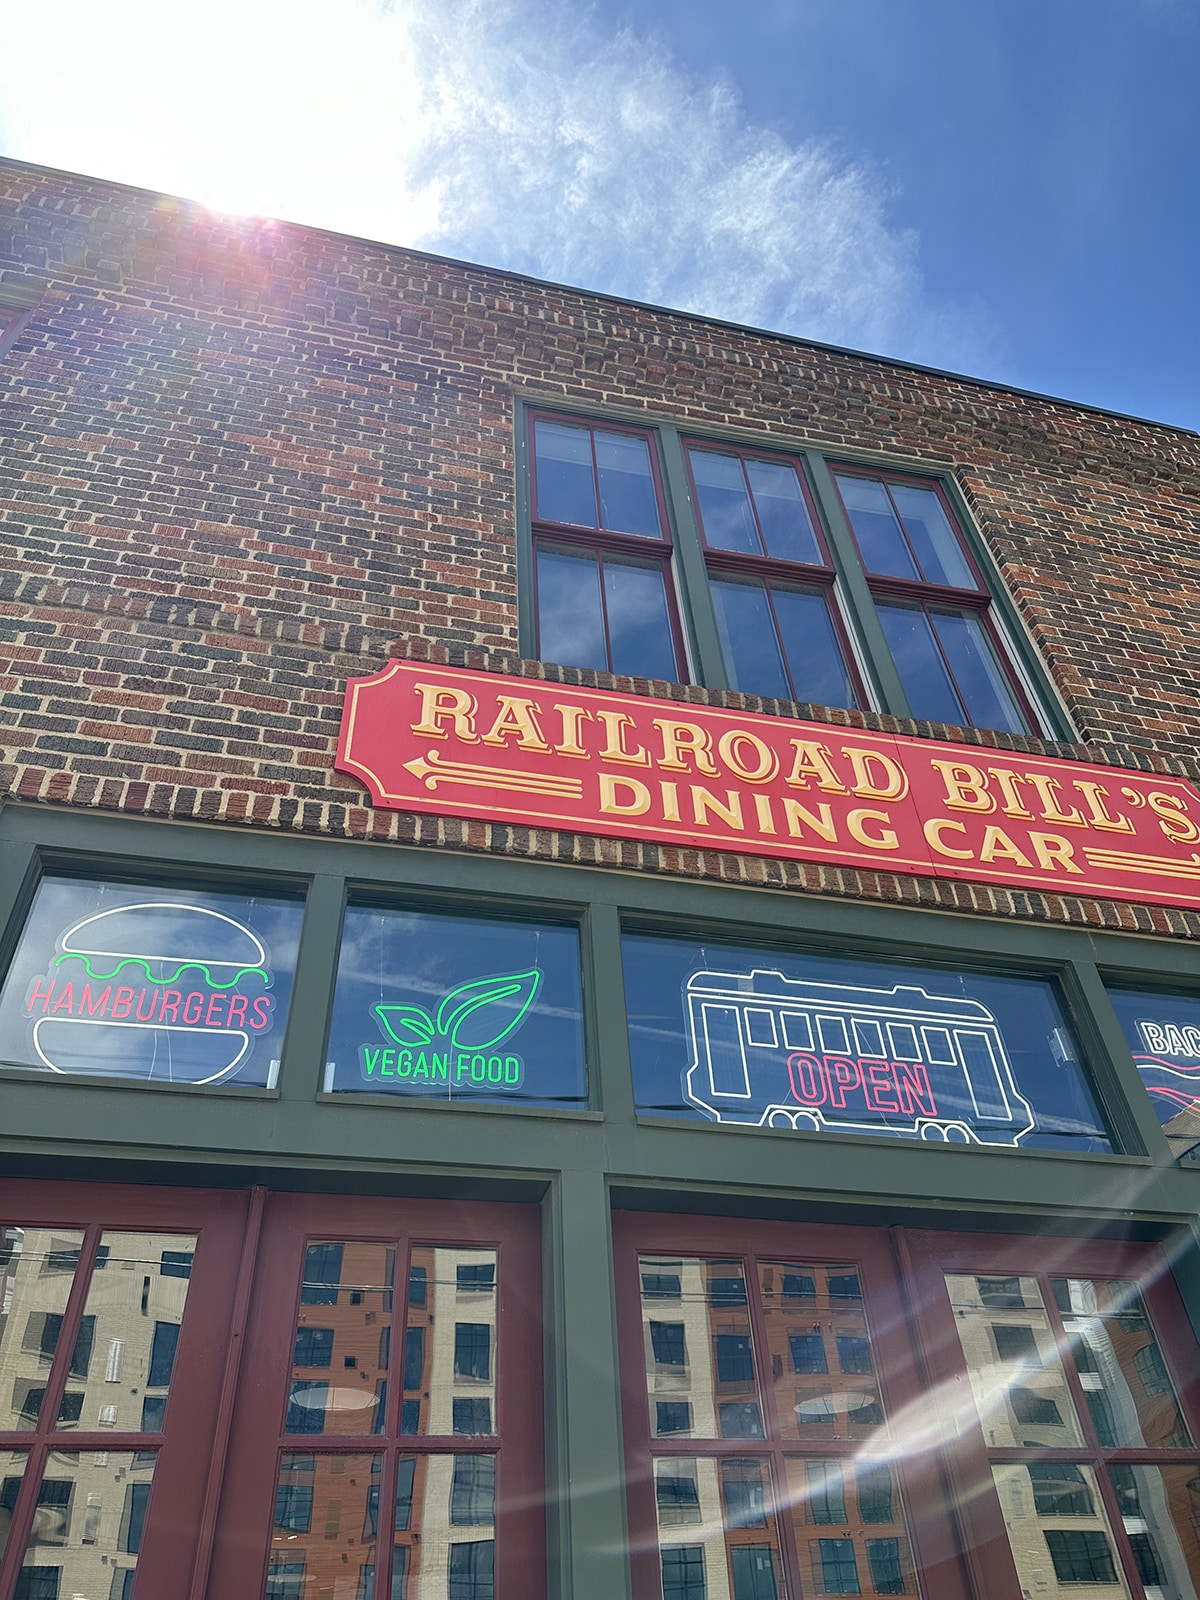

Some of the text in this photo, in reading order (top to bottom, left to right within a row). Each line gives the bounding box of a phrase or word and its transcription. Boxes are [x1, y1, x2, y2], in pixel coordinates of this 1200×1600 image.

[410, 683, 1200, 845] RAILROAD BILL'S
[597, 772, 1085, 875] DINING CAR
[27, 979, 272, 1030] HAMBURGERS
[364, 1048, 520, 1084] VEGAN FOOD
[787, 1052, 938, 1116] OPEN
